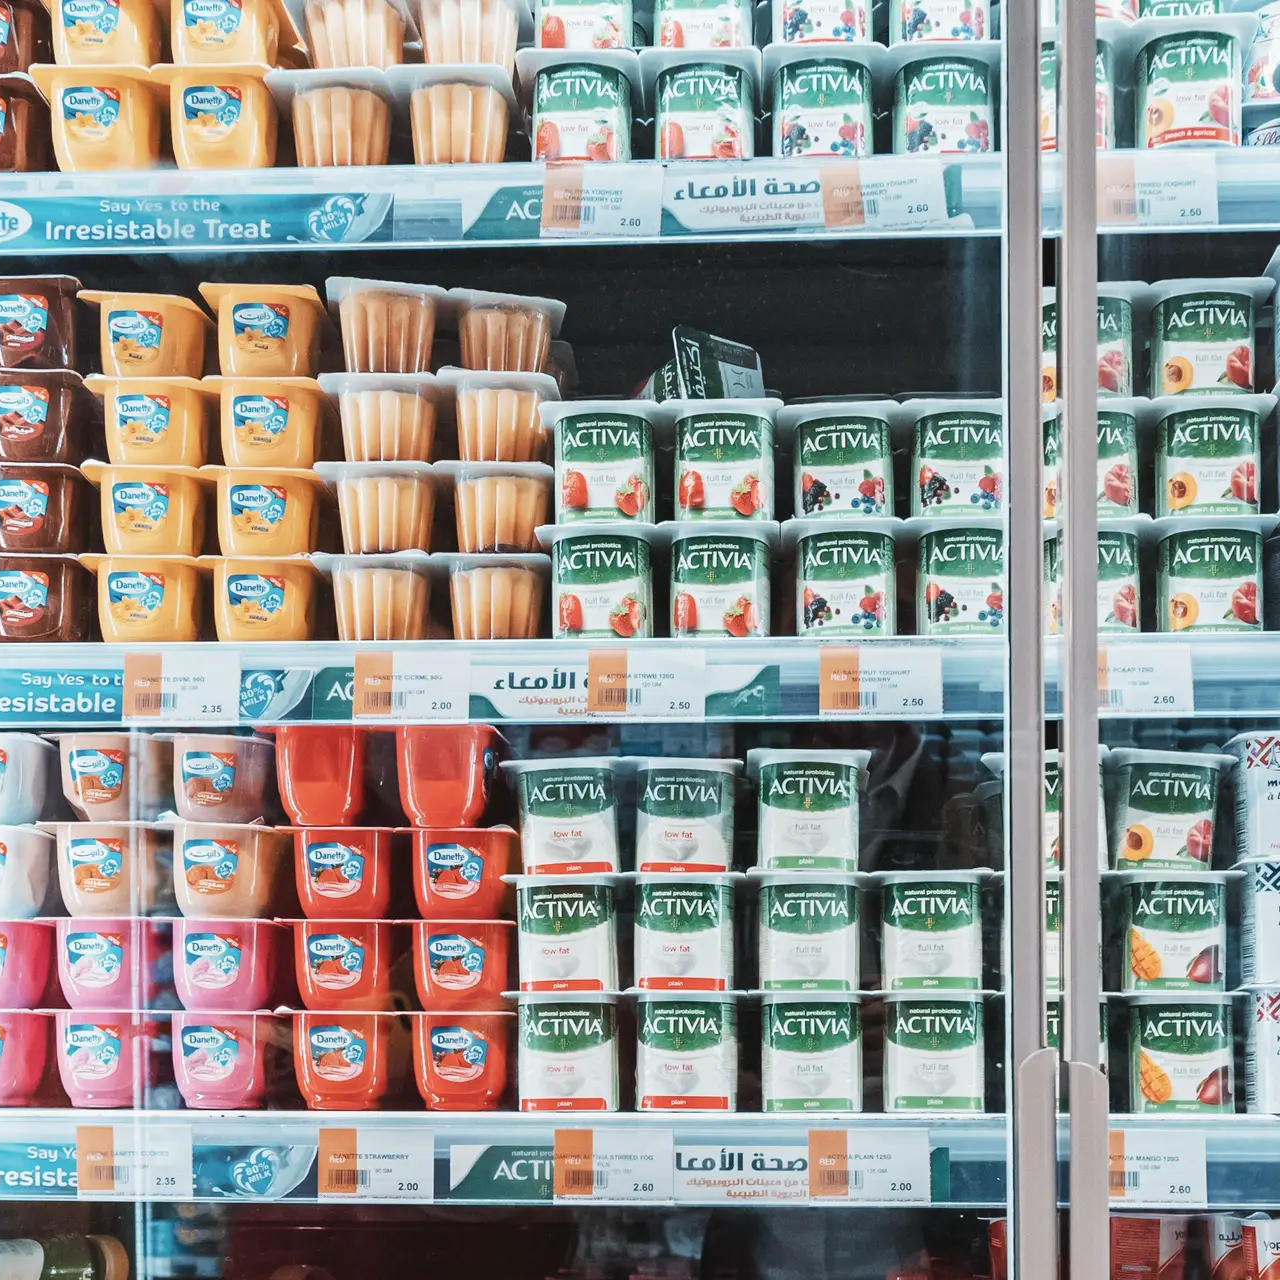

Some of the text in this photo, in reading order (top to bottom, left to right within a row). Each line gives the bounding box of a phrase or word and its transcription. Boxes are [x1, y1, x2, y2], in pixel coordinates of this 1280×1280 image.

[69, 94, 102, 107] Danette
[673, 179, 757, 200] الأمعاء
[99, 198, 220, 217] Say Yes to the
[1179, 208, 1202, 217] 2.50
[620, 217, 642, 227] 2.60
[45, 219, 271, 241] Irresistable Treat
[603, 420, 628, 428] probiotics
[1214, 417, 1240, 425] probiotics
[563, 429, 640, 449] ACTIVIA
[1171, 424, 1252, 445] ACTIVIA
[119, 489, 151, 503] Danette
[21, 673, 110, 688] Say Yes to
[430, 701, 452, 710] 2.00
[669, 701, 691, 710] 2.50
[902, 698, 924, 707] 2.50
[1153, 696, 1175, 705] 2.60
[201, 704, 222, 714] 2.35
[530, 782, 607, 803] ACTIVIA
[769, 778, 847, 797] ACTIVIA
[553, 829, 582, 838] low fat
[315, 849, 348, 863] Danette
[566, 863, 582, 872] plain
[1136, 897, 1216, 916] ACTIVIA
[436, 1033, 468, 1046] Danette
[26, 1145, 57, 1161] Say
[751, 1152, 808, 1173] صحة
[1135, 1155, 1160, 1163] MANGO
[155, 1177, 177, 1186] 2.35
[398, 1182, 419, 1192] 2.00
[633, 1182, 654, 1192] 2.60
[890, 1182, 912, 1192] 2.00
[1169, 1184, 1191, 1194] 2.60
